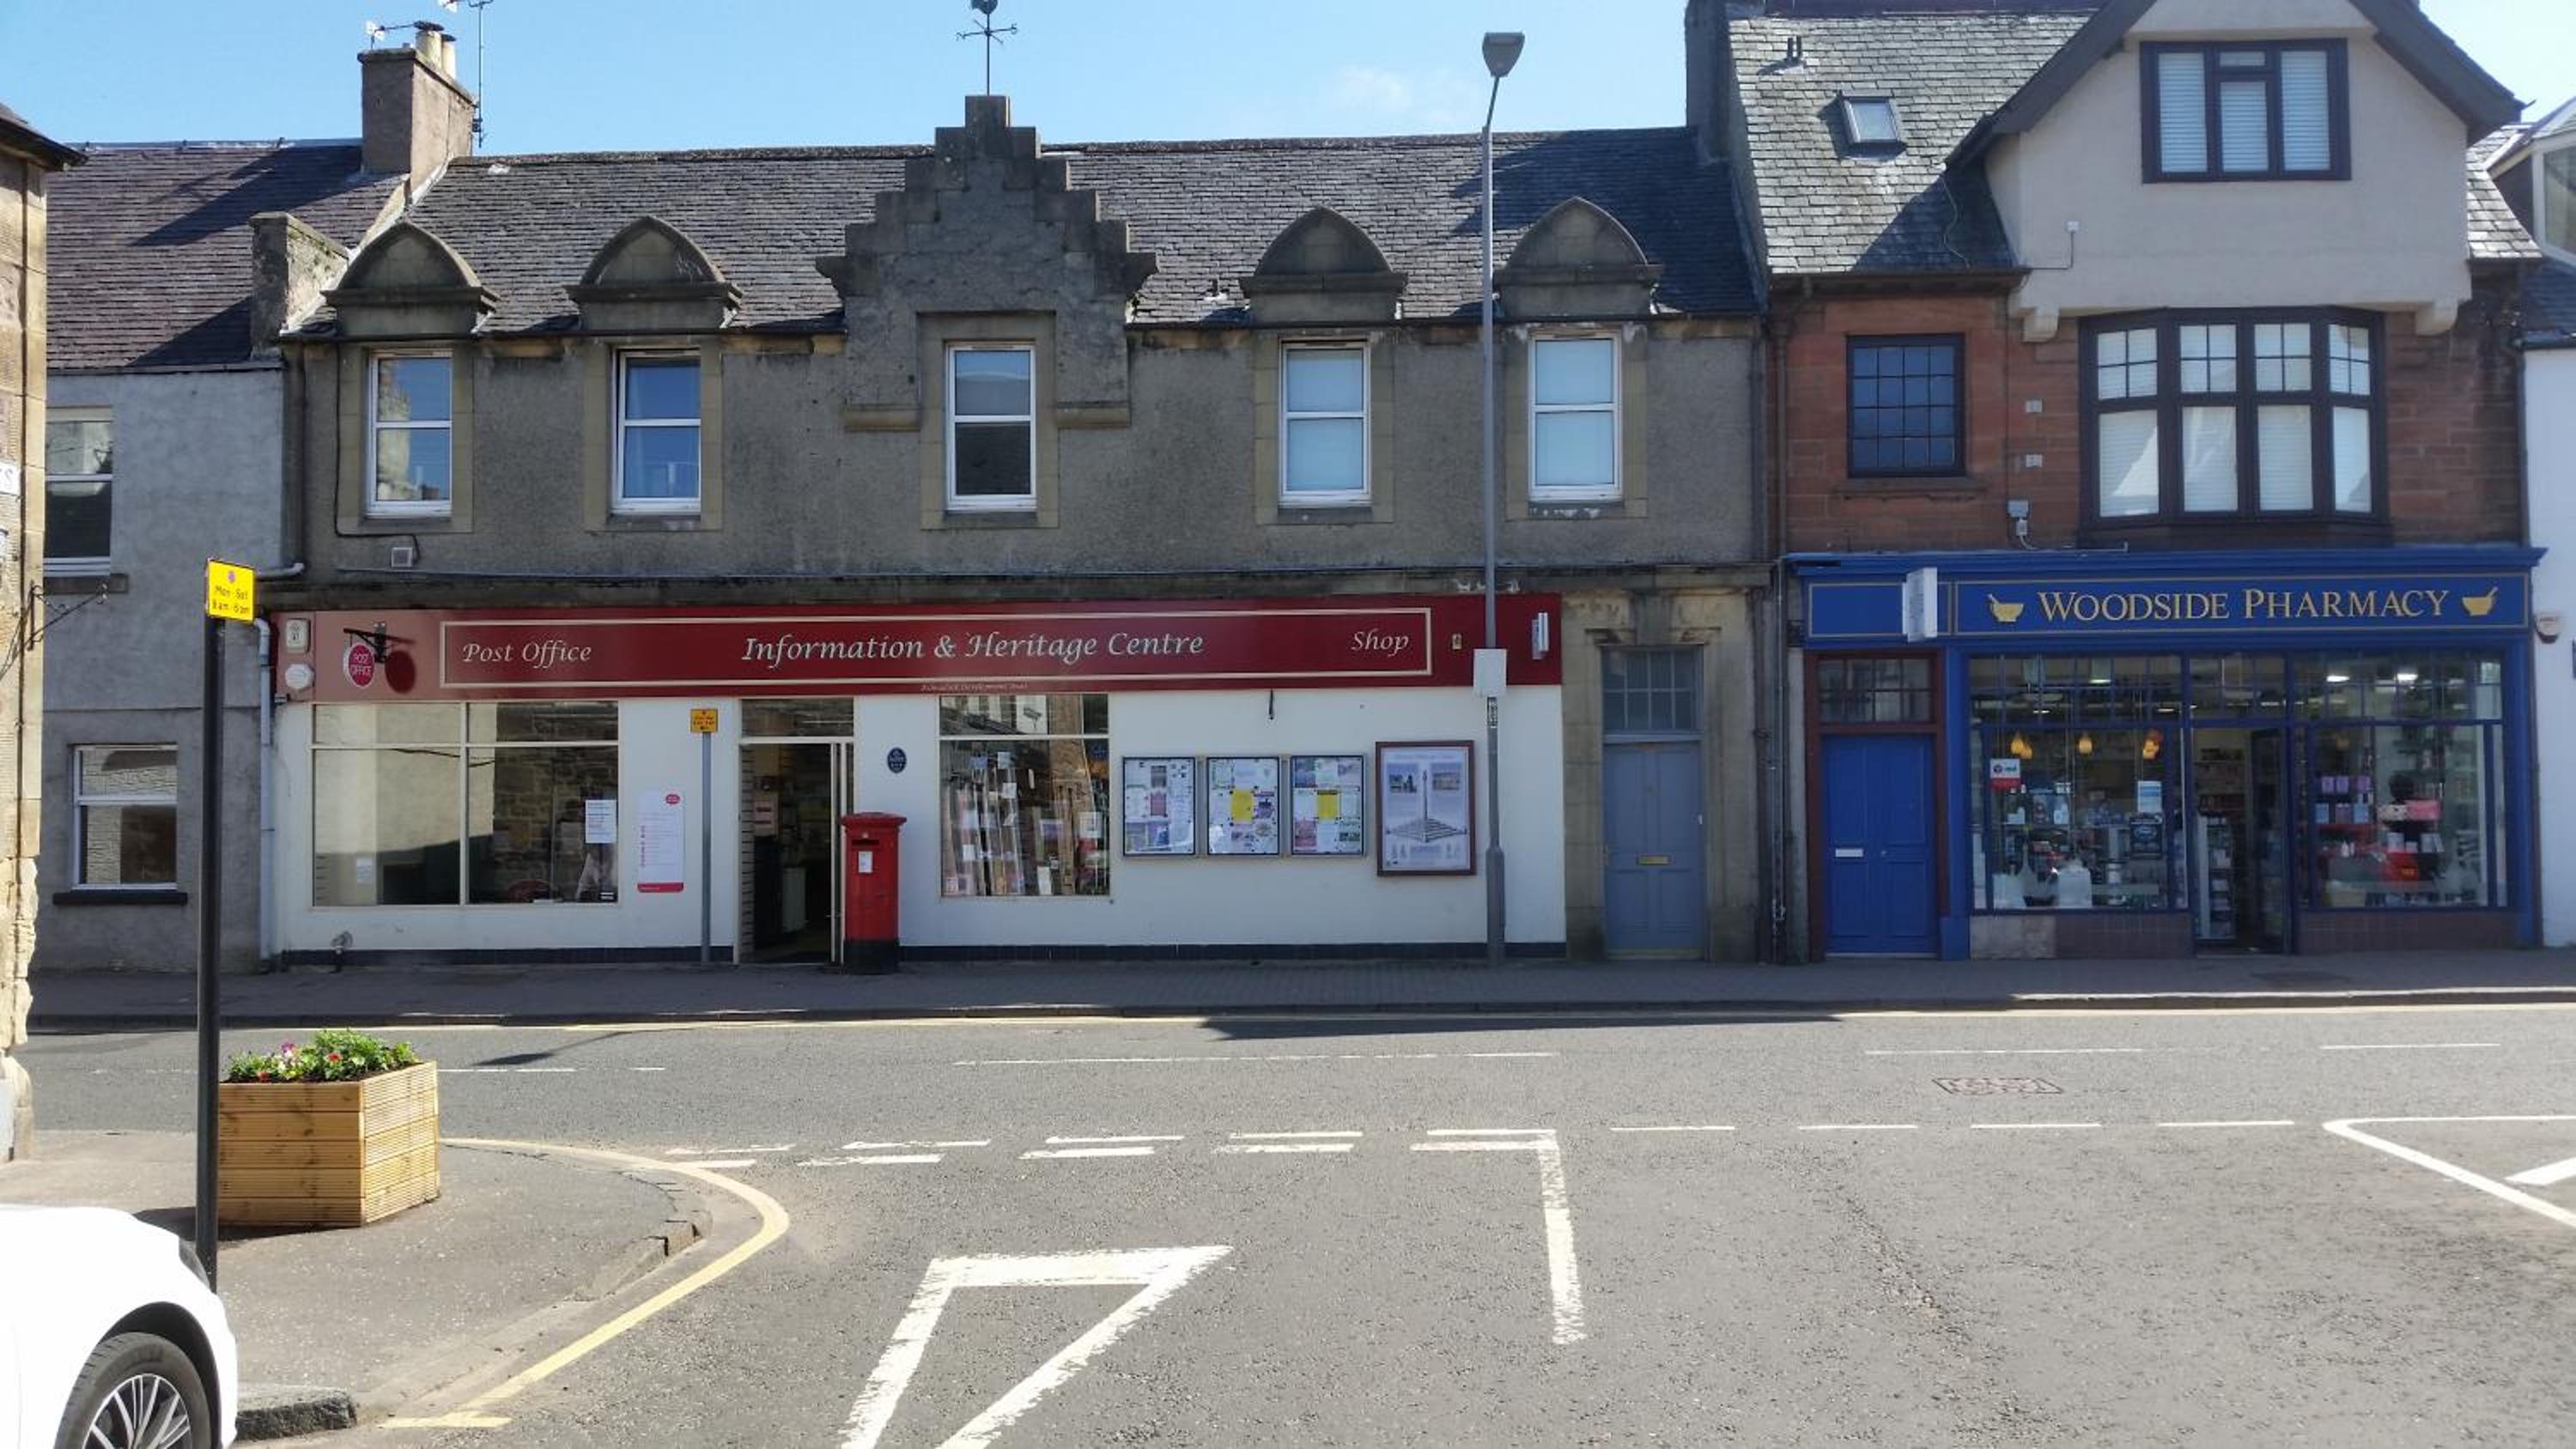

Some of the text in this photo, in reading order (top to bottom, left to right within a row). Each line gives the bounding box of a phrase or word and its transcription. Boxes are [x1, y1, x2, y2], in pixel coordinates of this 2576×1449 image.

[2037, 588, 2450, 621] WOODSIDE PHARMACY
[462, 640, 592, 669] Post Office
[741, 631, 1204, 669] Information & Heritage Centre
[1351, 627, 1410, 658] Shop
[350, 664, 372, 676] OFFICE
